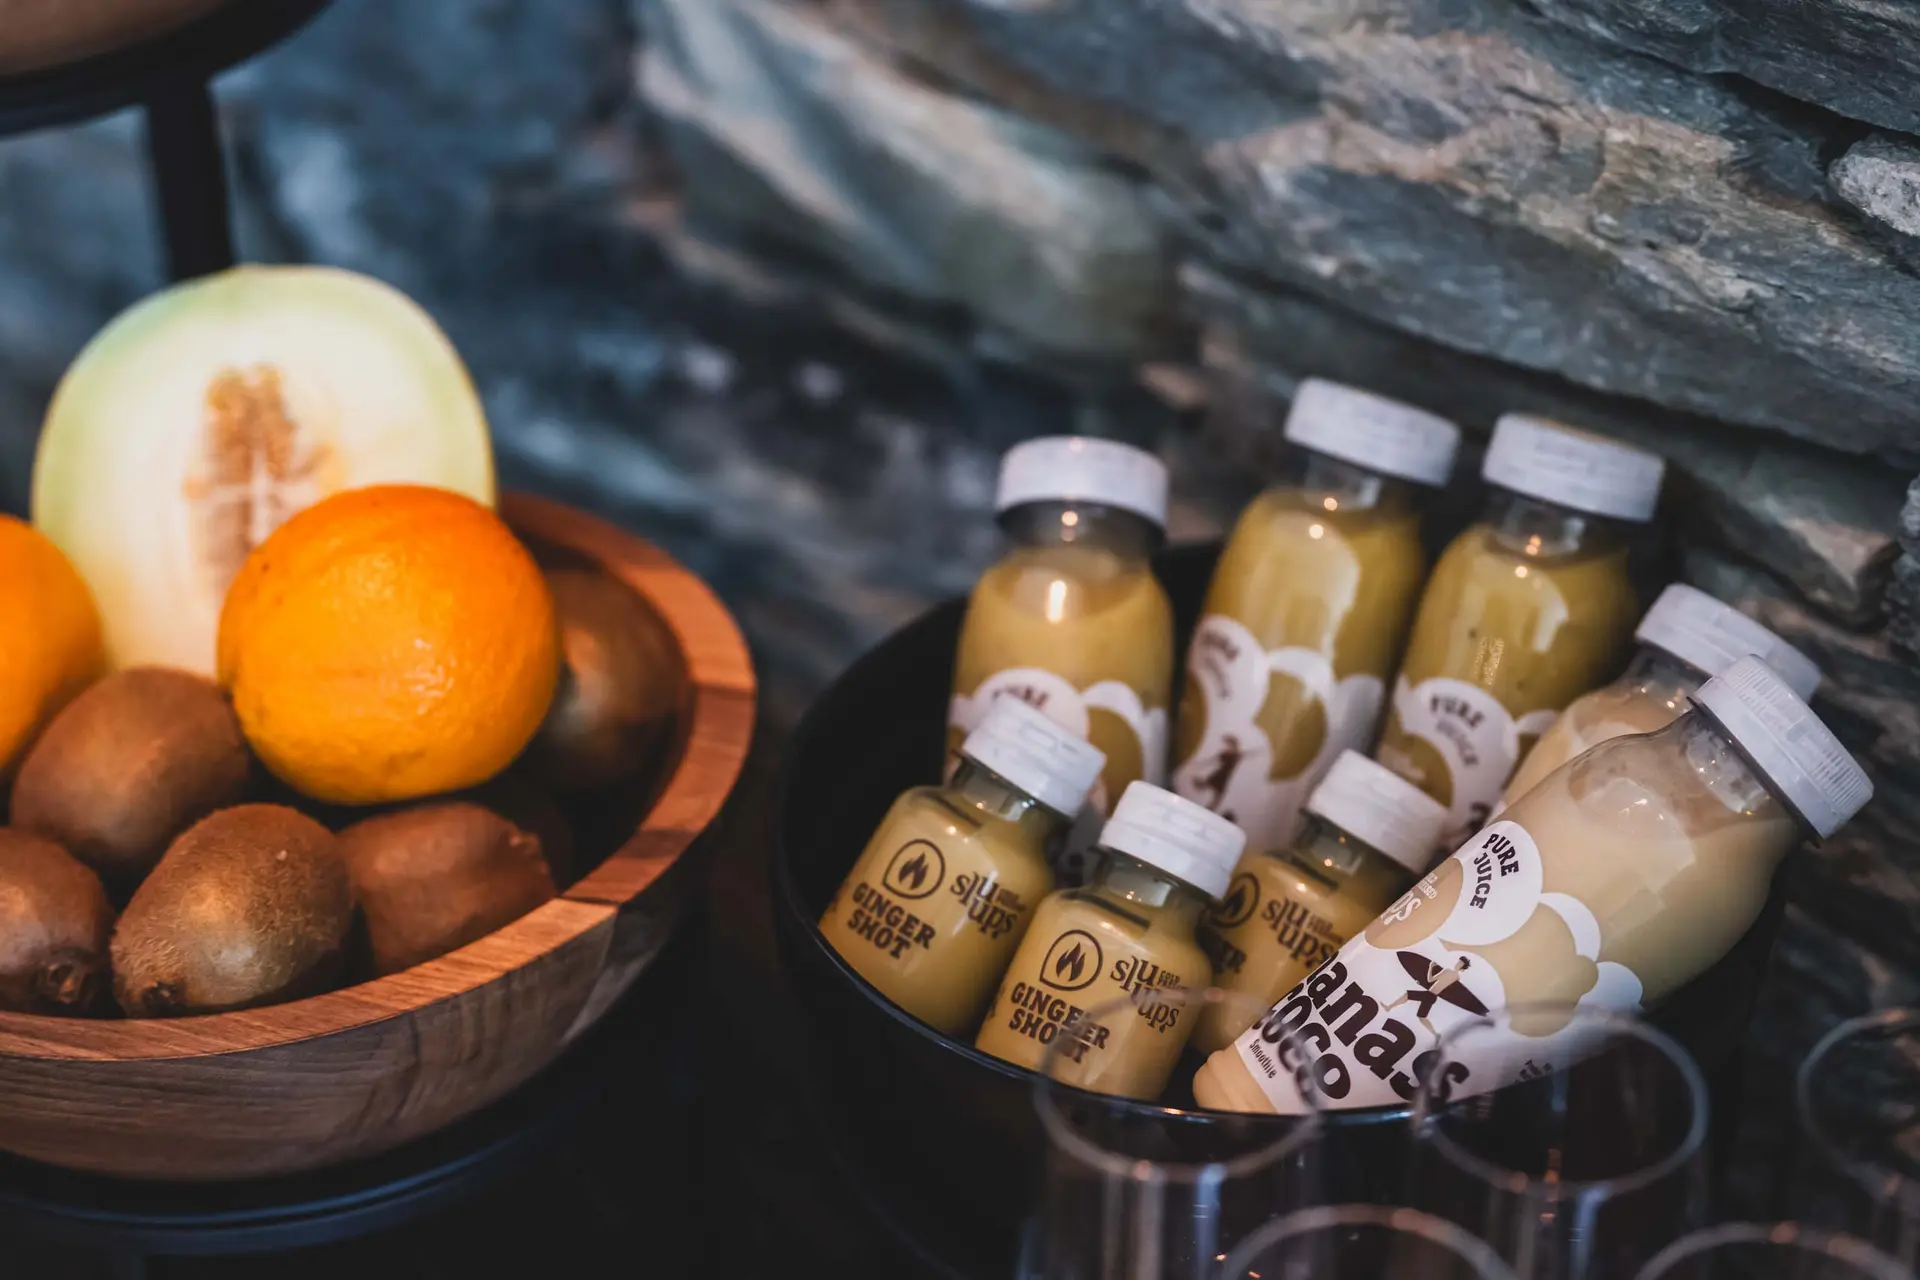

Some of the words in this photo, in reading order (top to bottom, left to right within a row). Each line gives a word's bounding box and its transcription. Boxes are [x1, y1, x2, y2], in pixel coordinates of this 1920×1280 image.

[1469, 852, 1493, 910] JUICE
[1482, 833, 1520, 877] PURE
[847, 908, 912, 960] SHOT
[852, 882, 936, 950] GINGER
[1010, 981, 1111, 1050] GINGER
[1288, 952, 1470, 1104] anas
[1249, 1038, 1278, 1079] Smoothie
